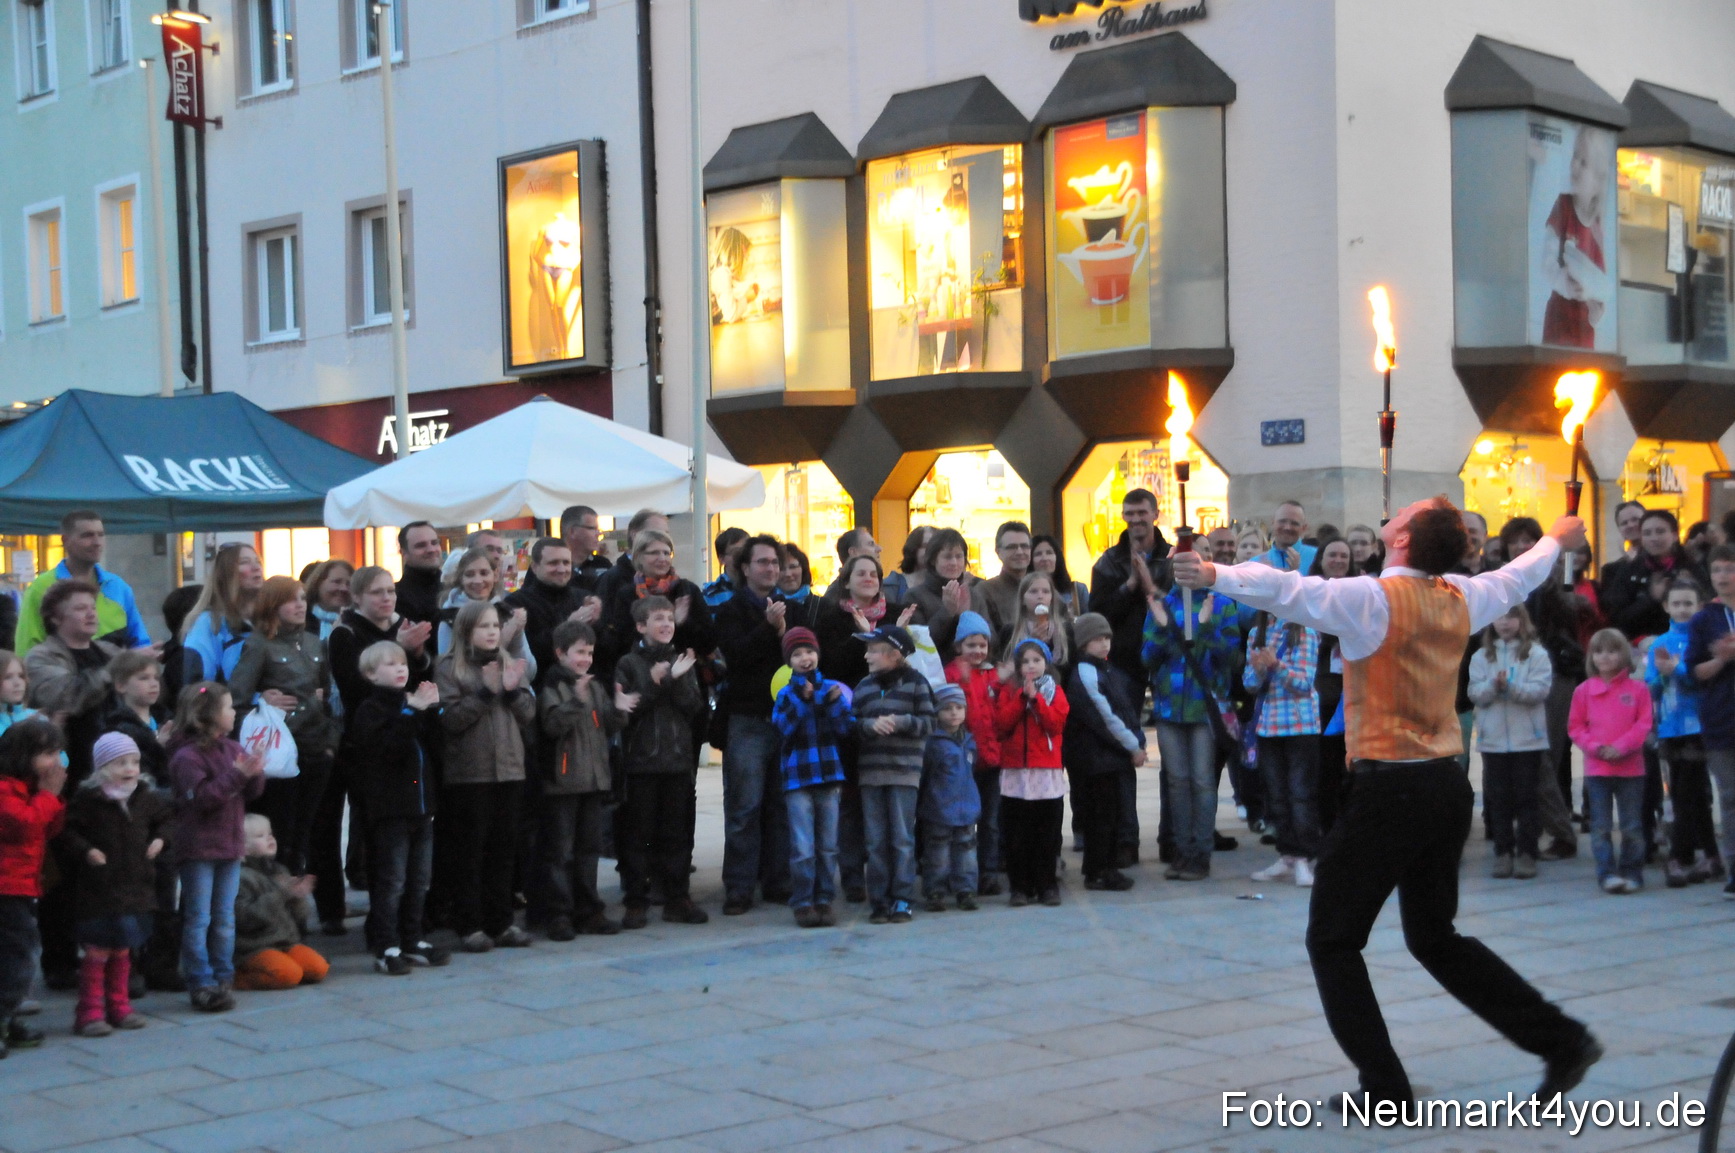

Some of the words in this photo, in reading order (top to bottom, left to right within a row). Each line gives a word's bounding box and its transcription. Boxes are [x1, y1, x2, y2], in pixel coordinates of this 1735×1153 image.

[1049, 29, 1091, 50] am
[1095, 1, 1207, 41] Rathaus
[170, 34, 198, 118] Achatz
[377, 409, 449, 455] Ahatz
[123, 455, 291, 492] RACKL
